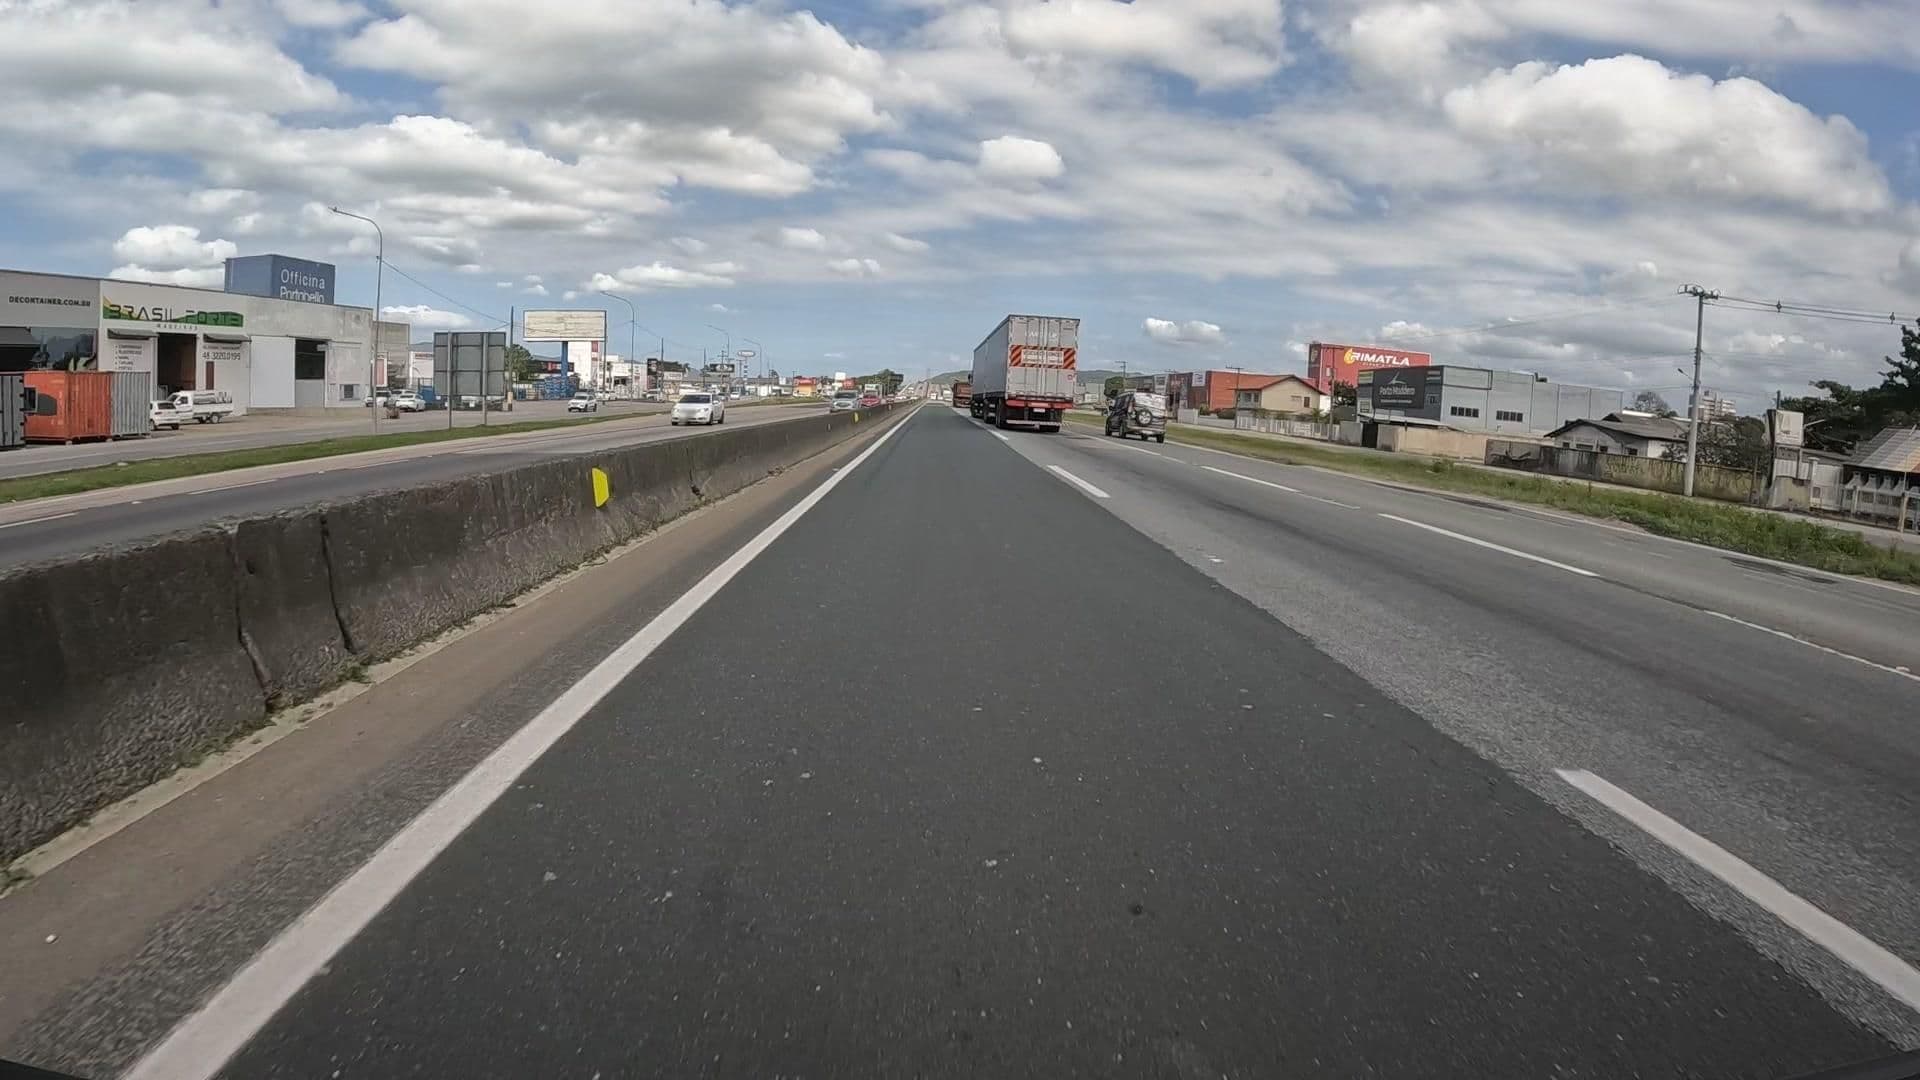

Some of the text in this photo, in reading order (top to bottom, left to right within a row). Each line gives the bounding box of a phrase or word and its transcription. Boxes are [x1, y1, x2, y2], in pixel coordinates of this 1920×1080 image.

[280, 268, 325, 289] Officina
[8, 295, 91, 307] DECONTAINER.COM.BR
[109, 304, 174, 321] BRASIL
